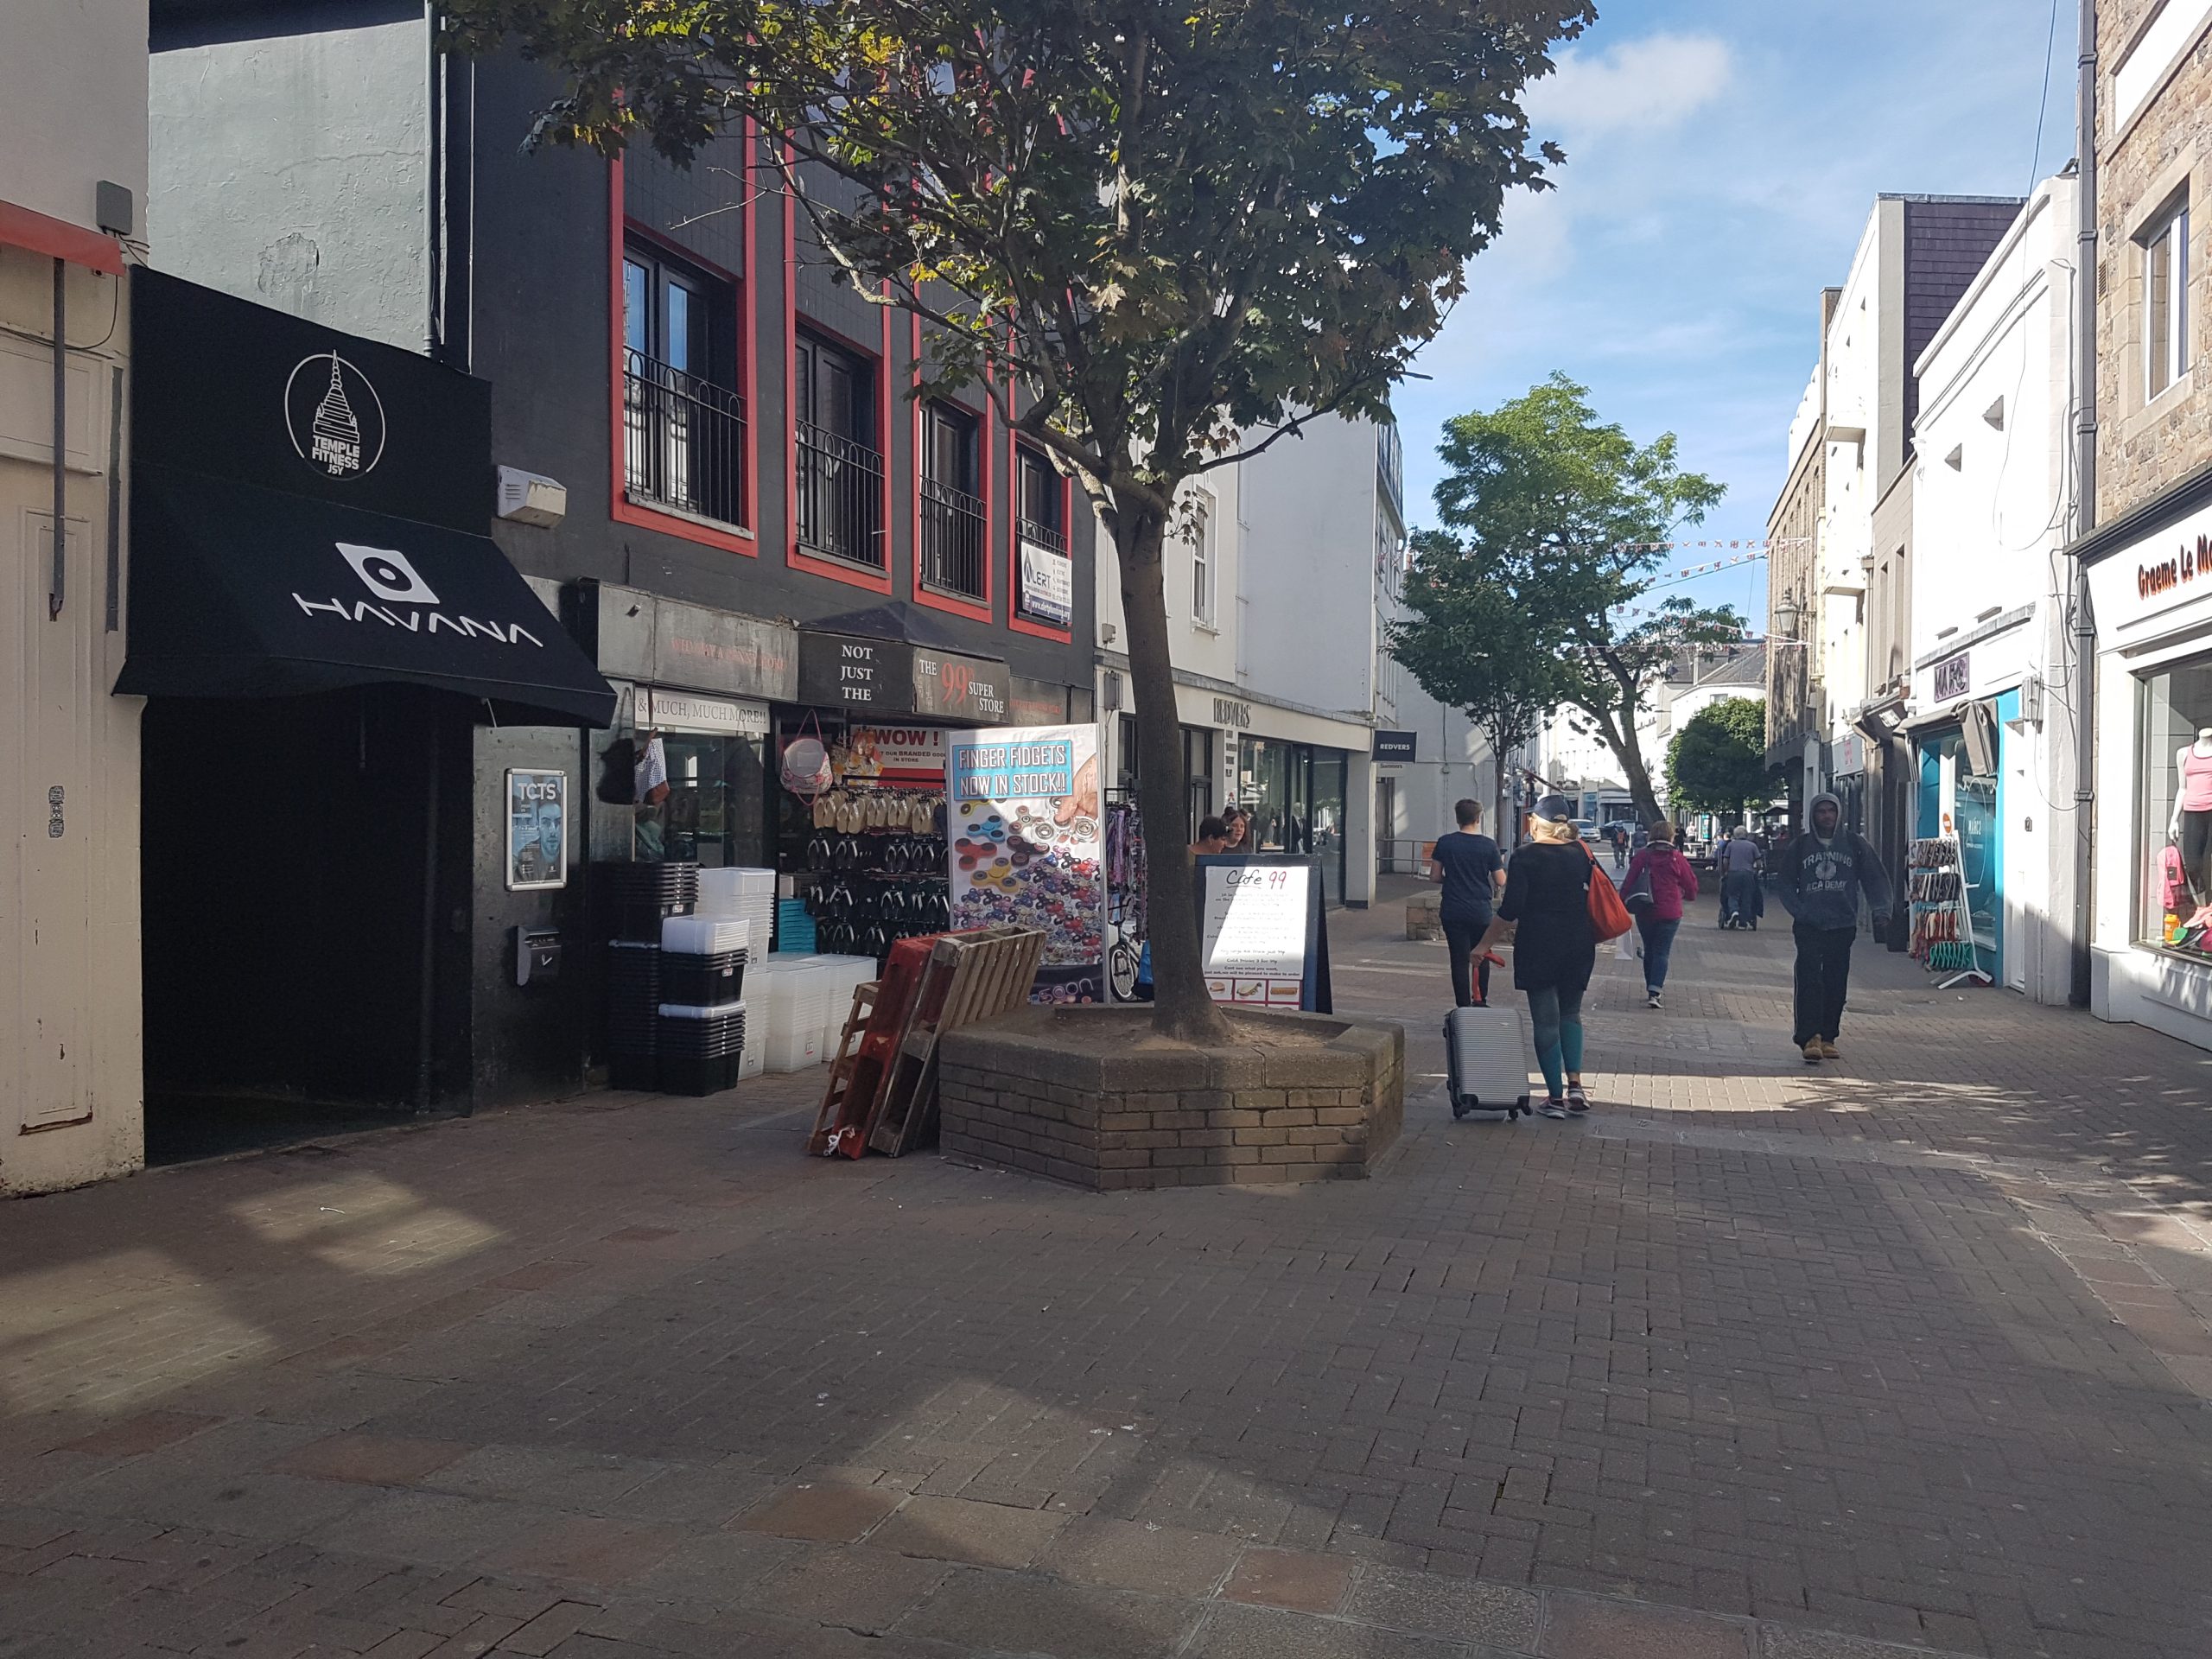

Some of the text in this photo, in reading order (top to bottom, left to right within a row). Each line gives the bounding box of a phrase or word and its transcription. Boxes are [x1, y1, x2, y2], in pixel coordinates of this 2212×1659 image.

[313, 435, 360, 458] TEMPLE
[312, 447, 359, 470] FITNESS
[327, 464, 344, 476] JSY
[2138, 563, 2177, 601] Graeme
[2180, 544, 2194, 584] Le
[292, 593, 543, 648] HAVANA
[841, 645, 873, 660] NOT
[840, 665, 873, 681] JUST
[919, 659, 937, 676] THE
[842, 686, 872, 701] THE
[969, 681, 995, 698] SUPER
[638, 697, 767, 725] & MUCH, MUCH MORE!!
[979, 697, 1004, 714] STORE
[1213, 697, 1251, 728] REDVERS
[874, 729, 927, 747] WOW
[959, 744, 1065, 770] FINGER FIDGETS
[518, 782, 556, 801] TCTS
[960, 772, 1066, 797] NOW IN STOCK!!
[1802, 851, 1853, 869] TRAINING
[1226, 868, 1287, 890] Cafe 99
[1806, 880, 1847, 893] ACADEMY
